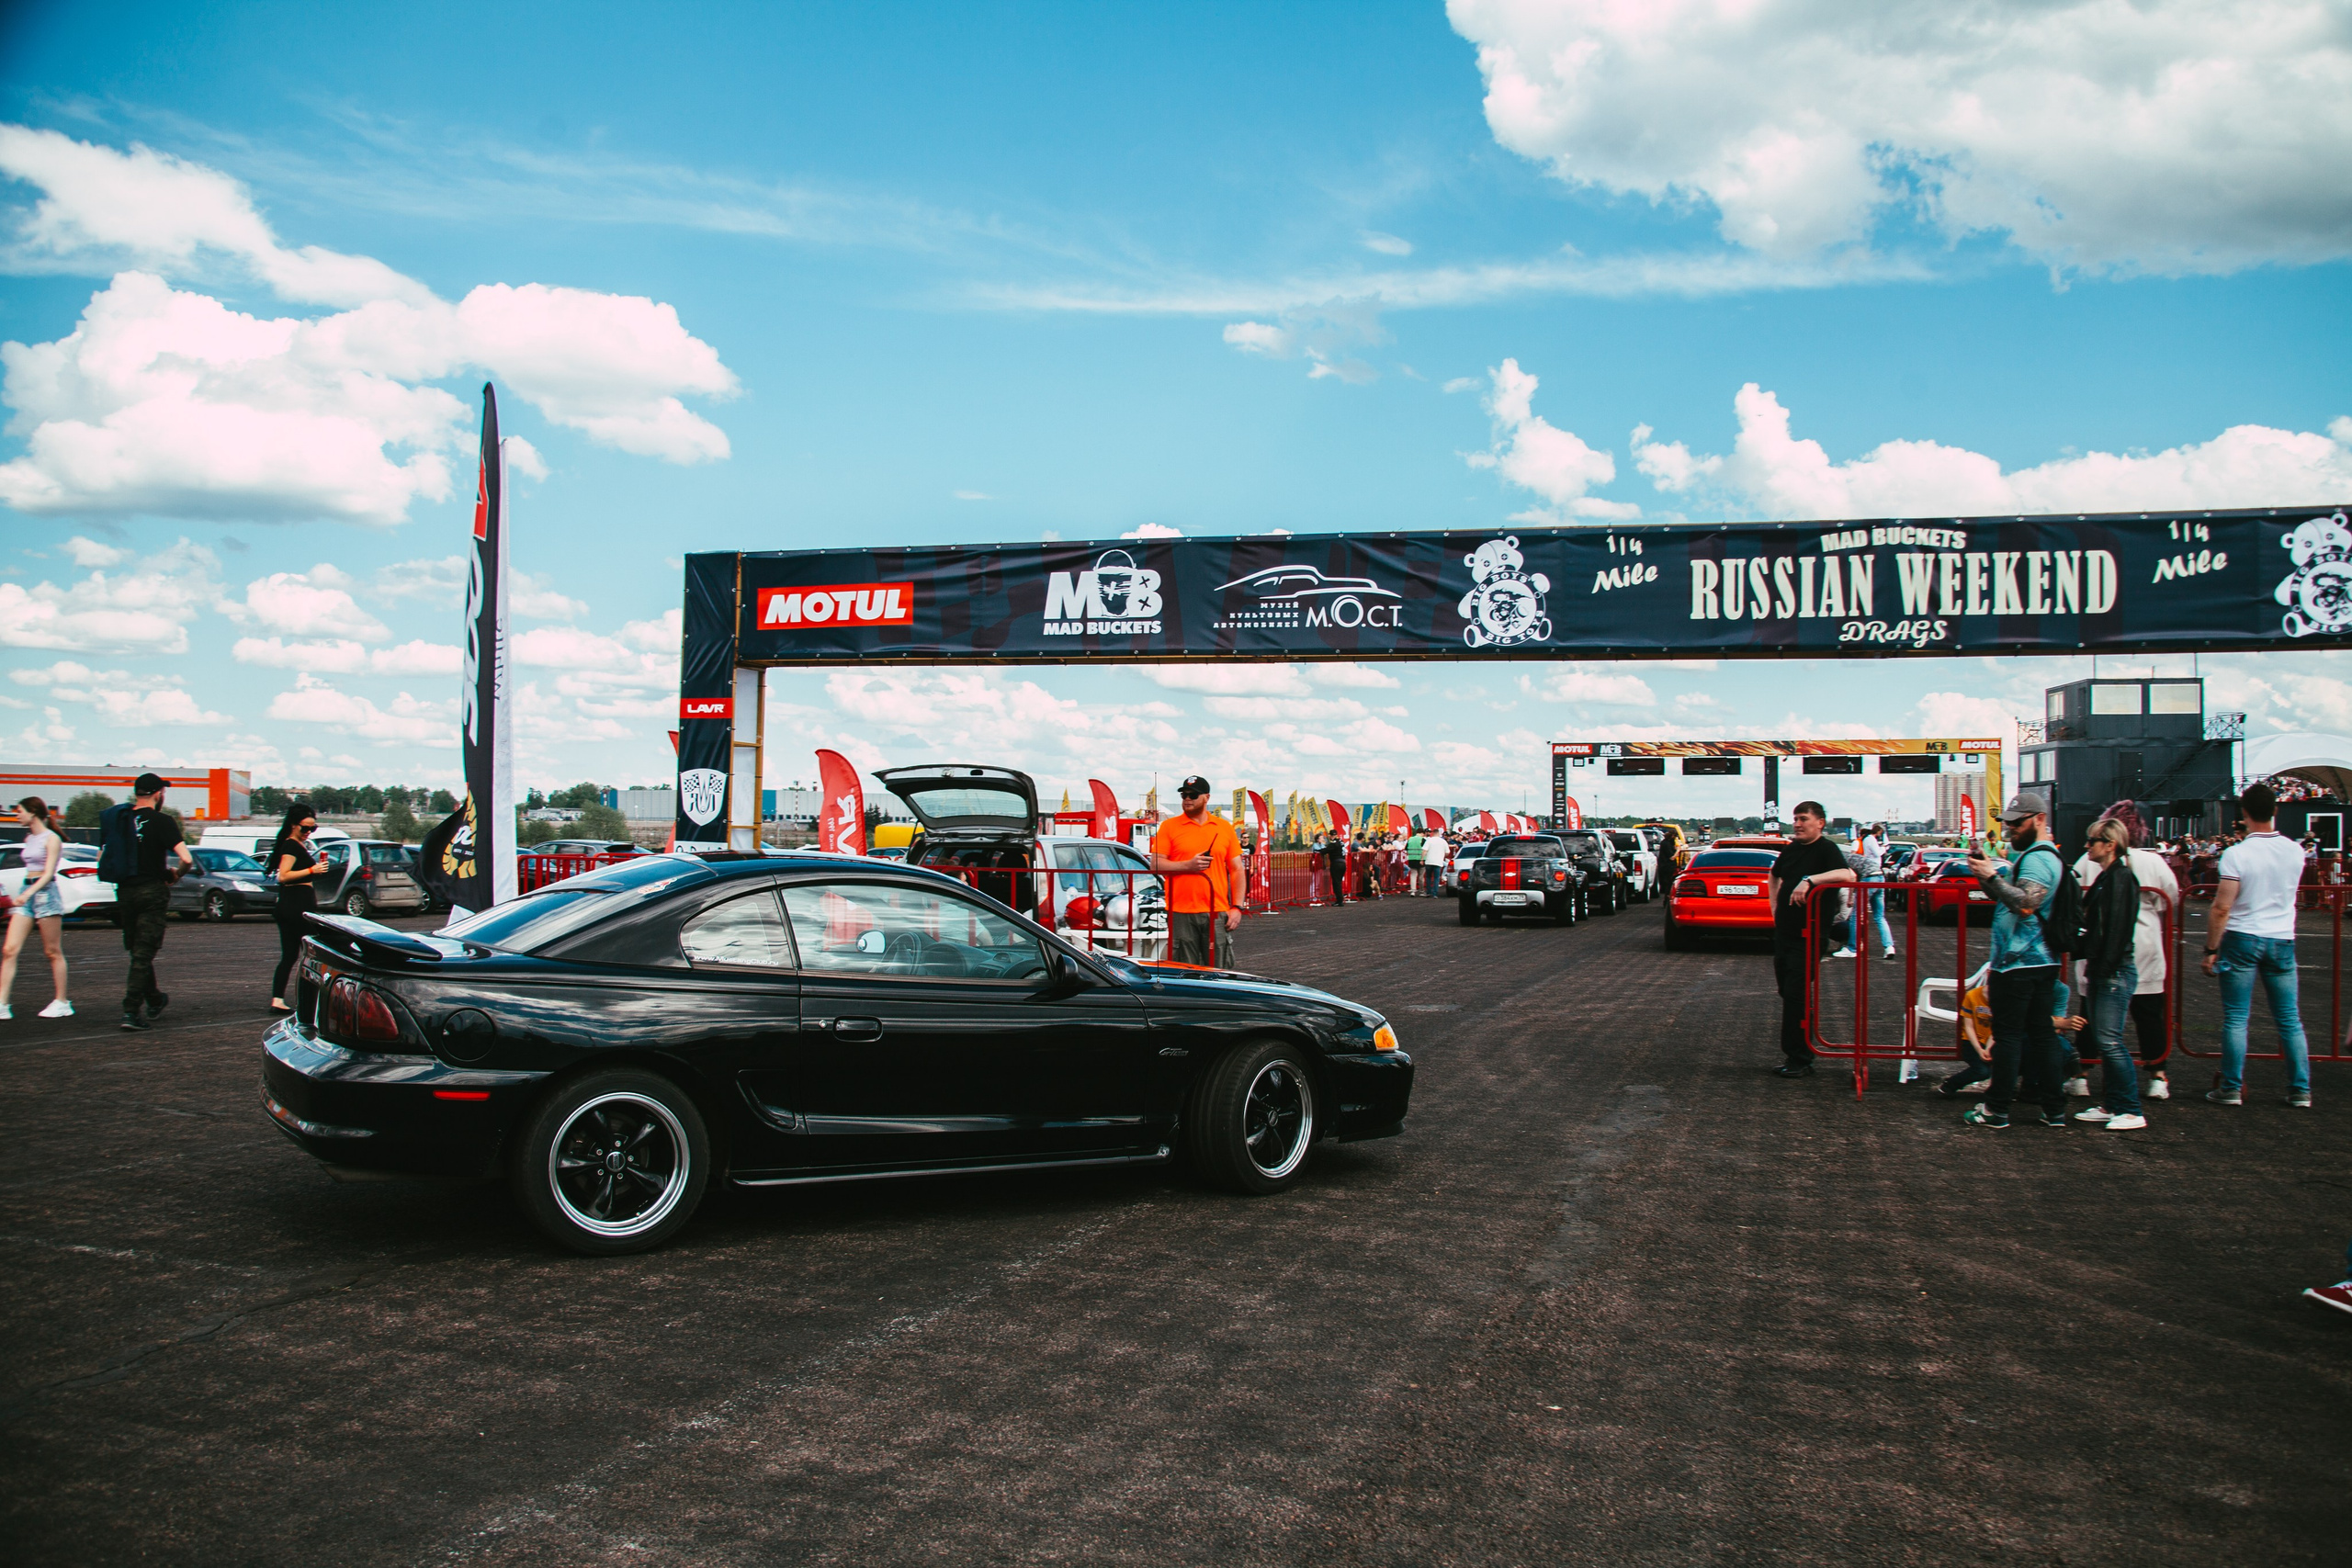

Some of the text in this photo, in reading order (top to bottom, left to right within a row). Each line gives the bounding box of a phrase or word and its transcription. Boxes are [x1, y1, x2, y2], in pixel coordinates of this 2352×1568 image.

[1821, 526, 1967, 552] MAD BUCKETS
[1593, 562, 1659, 595] Mile
[2151, 549, 2228, 584] Mile
[1471, 584, 1487, 606] BIG
[1690, 549, 2118, 620] RUSSIAN WEEKEND
[763, 589, 907, 624] MOTUL
[1043, 621, 1161, 635] MAD BUCKETS
[1485, 610, 1544, 644] BIG TOYS
[1838, 620, 1948, 648] DRAGS
[687, 704, 724, 714] LAVR
[1960, 741, 2001, 750] MOTUL
[694, 954, 779, 966] www.MustangClub.ru
